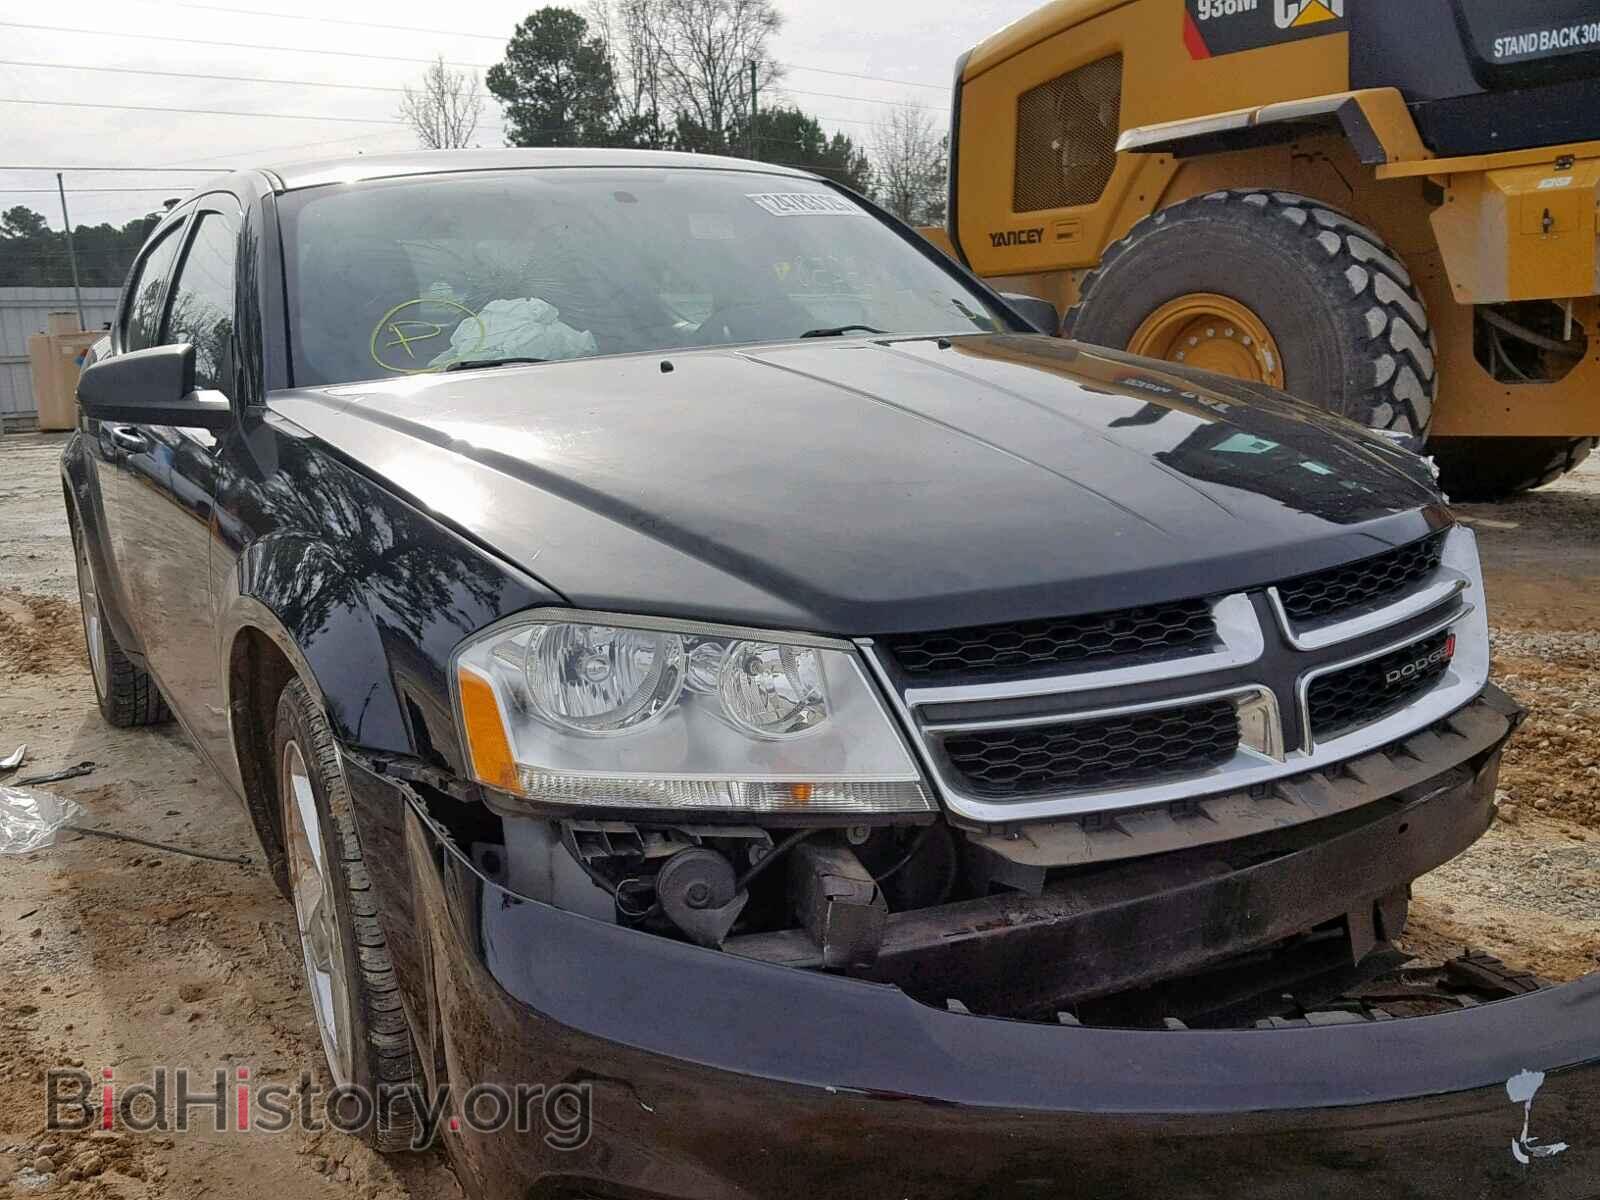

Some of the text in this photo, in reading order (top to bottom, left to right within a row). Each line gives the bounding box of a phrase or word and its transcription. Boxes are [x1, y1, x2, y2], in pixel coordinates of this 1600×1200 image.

[1494, 22, 1600, 57] STAND BACK 30
[988, 228, 1045, 247] YANCEY
[1386, 646, 1449, 683] DODGE
